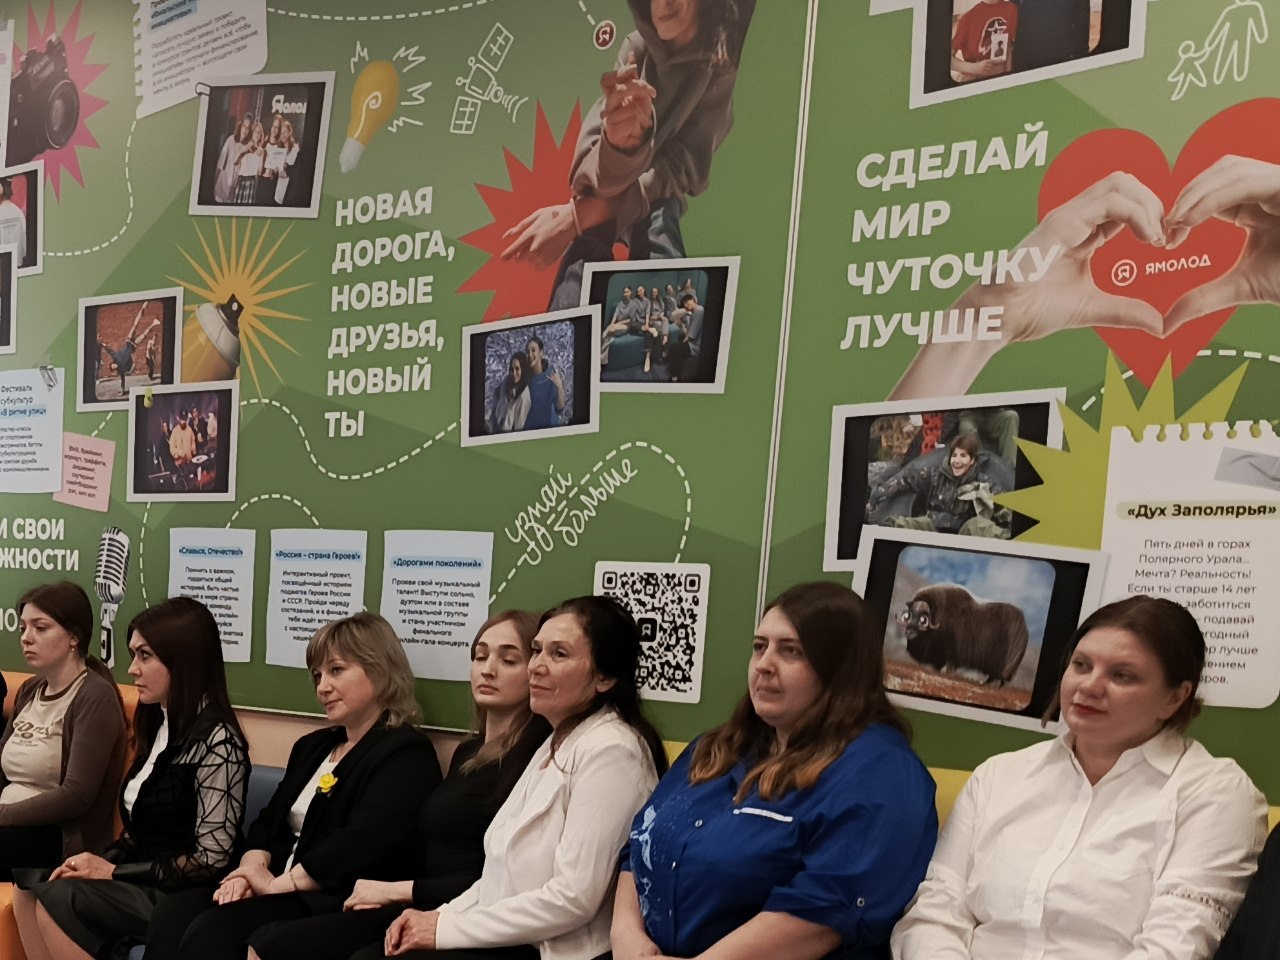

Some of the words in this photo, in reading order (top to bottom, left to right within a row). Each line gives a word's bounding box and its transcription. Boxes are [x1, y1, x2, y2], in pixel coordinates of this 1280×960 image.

[856, 121, 1049, 192] СДЕЛАЙ
[336, 186, 433, 227] НОВАЯ
[851, 200, 951, 242] МИР
[331, 230, 455, 275] ДОРОГА,
[847, 244, 1062, 296] ЧУТОЧКУ
[1145, 254, 1211, 276] ЯМОЛОД
[331, 275, 434, 312] НОВЫЕ
[840, 306, 1005, 350] ЛУЧШЕ
[327, 319, 445, 359] ДРУЗЬЯ,
[327, 356, 432, 396] НОВЫЙ
[324, 410, 365, 438] ТЫ
[553, 459, 639, 546] больше
[1127, 504, 1167, 519] «Дух
[1171, 503, 1277, 518] Заполярья»
[12, 517, 65, 540] СВОИ
[1144, 539, 1171, 549] Пять
[1173, 538, 1204, 550] дней
[1217, 541, 1251, 552] горах
[276, 550, 302, 558] «Россия
[307, 552, 331, 560] страна
[331, 551, 361, 561] Героев!»
[393, 558, 434, 568] «Дорогами
[435, 559, 482, 568] поколений»
[1139, 554, 1203, 566] Полярного
[392, 578, 416, 586] Прояви
[434, 580, 481, 588] музыкальный
[1134, 569, 1177, 579] Мечта?
[1180, 569, 1251, 580] Реальность!
[420, 589, 449, 597] Выступи
[450, 591, 476, 599] сольно,
[1127, 583, 1154, 594] Если
[1158, 585, 1171, 594] ты
[1174, 586, 1218, 595] старше
[1222, 584, 1233, 594] 14
[1235, 585, 1257, 594] лет
[443, 610, 469, 618] группы
[1203, 615, 1255, 625] подавай
[412, 627, 452, 636] финального
[1218, 645, 1259, 656] лучше
